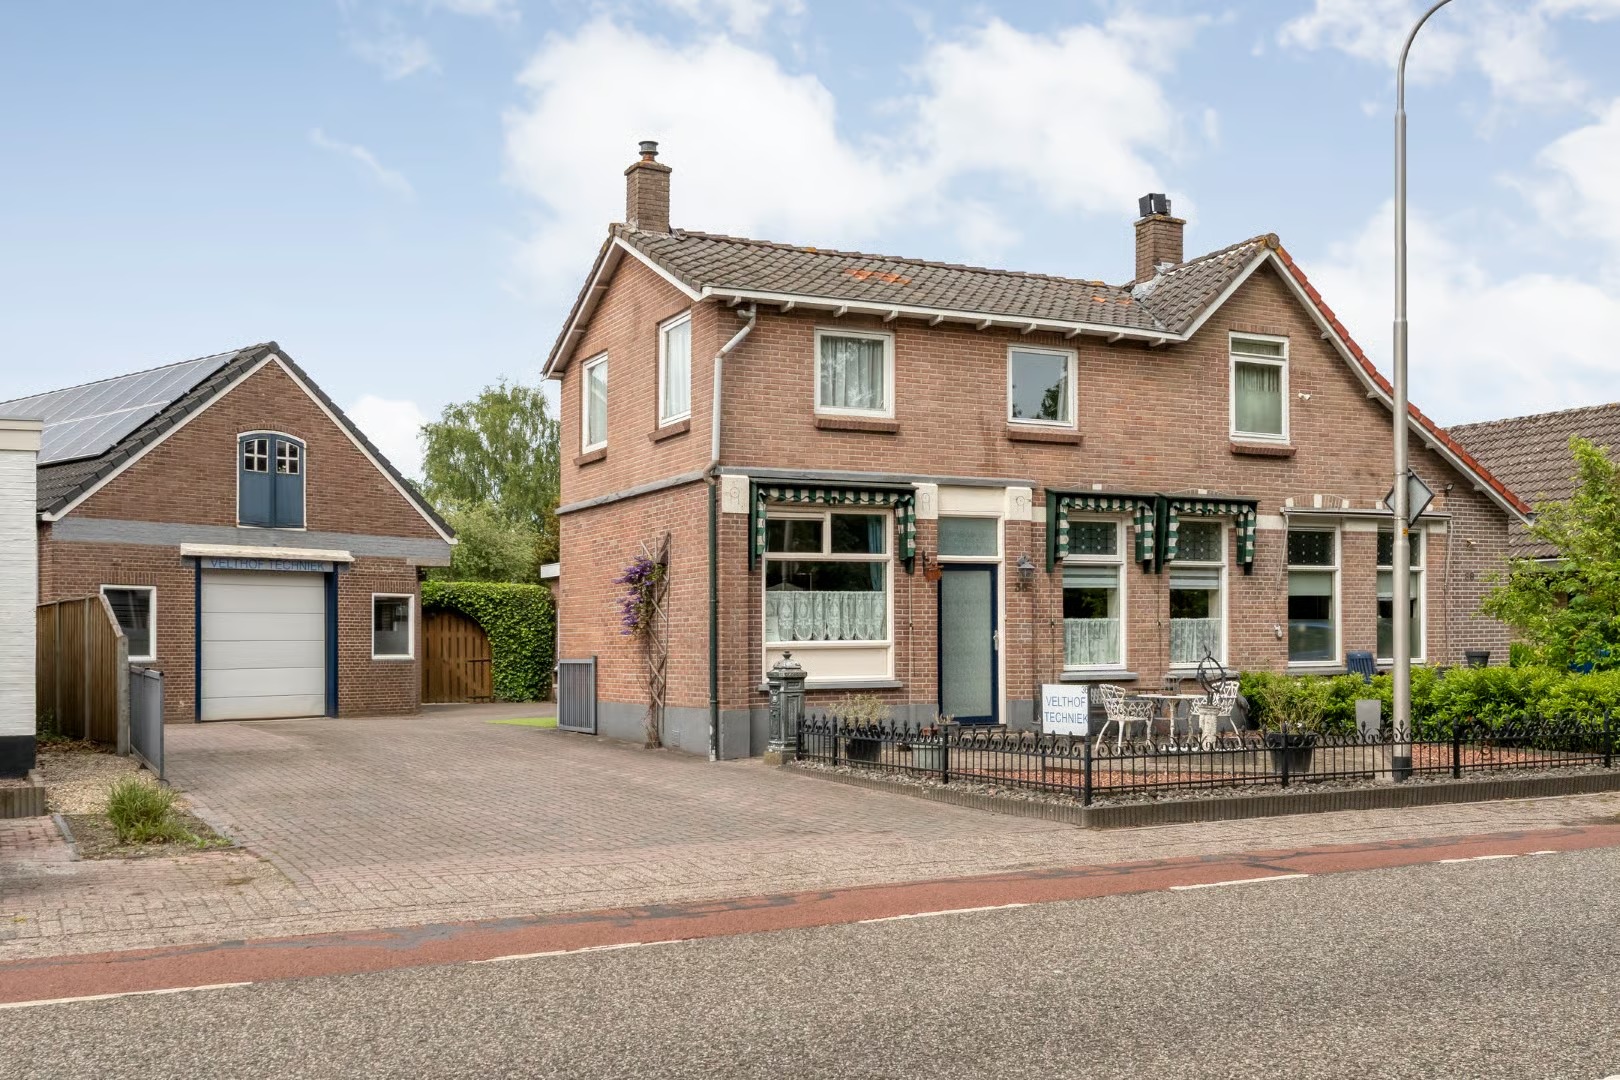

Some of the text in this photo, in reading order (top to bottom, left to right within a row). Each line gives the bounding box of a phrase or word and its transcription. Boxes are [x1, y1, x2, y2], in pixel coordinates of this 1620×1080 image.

[210, 558, 325, 571] VELTHOF TECHNIEK
[1045, 695, 1087, 707] VELTHOF
[1044, 711, 1088, 724] TECHNIEK
